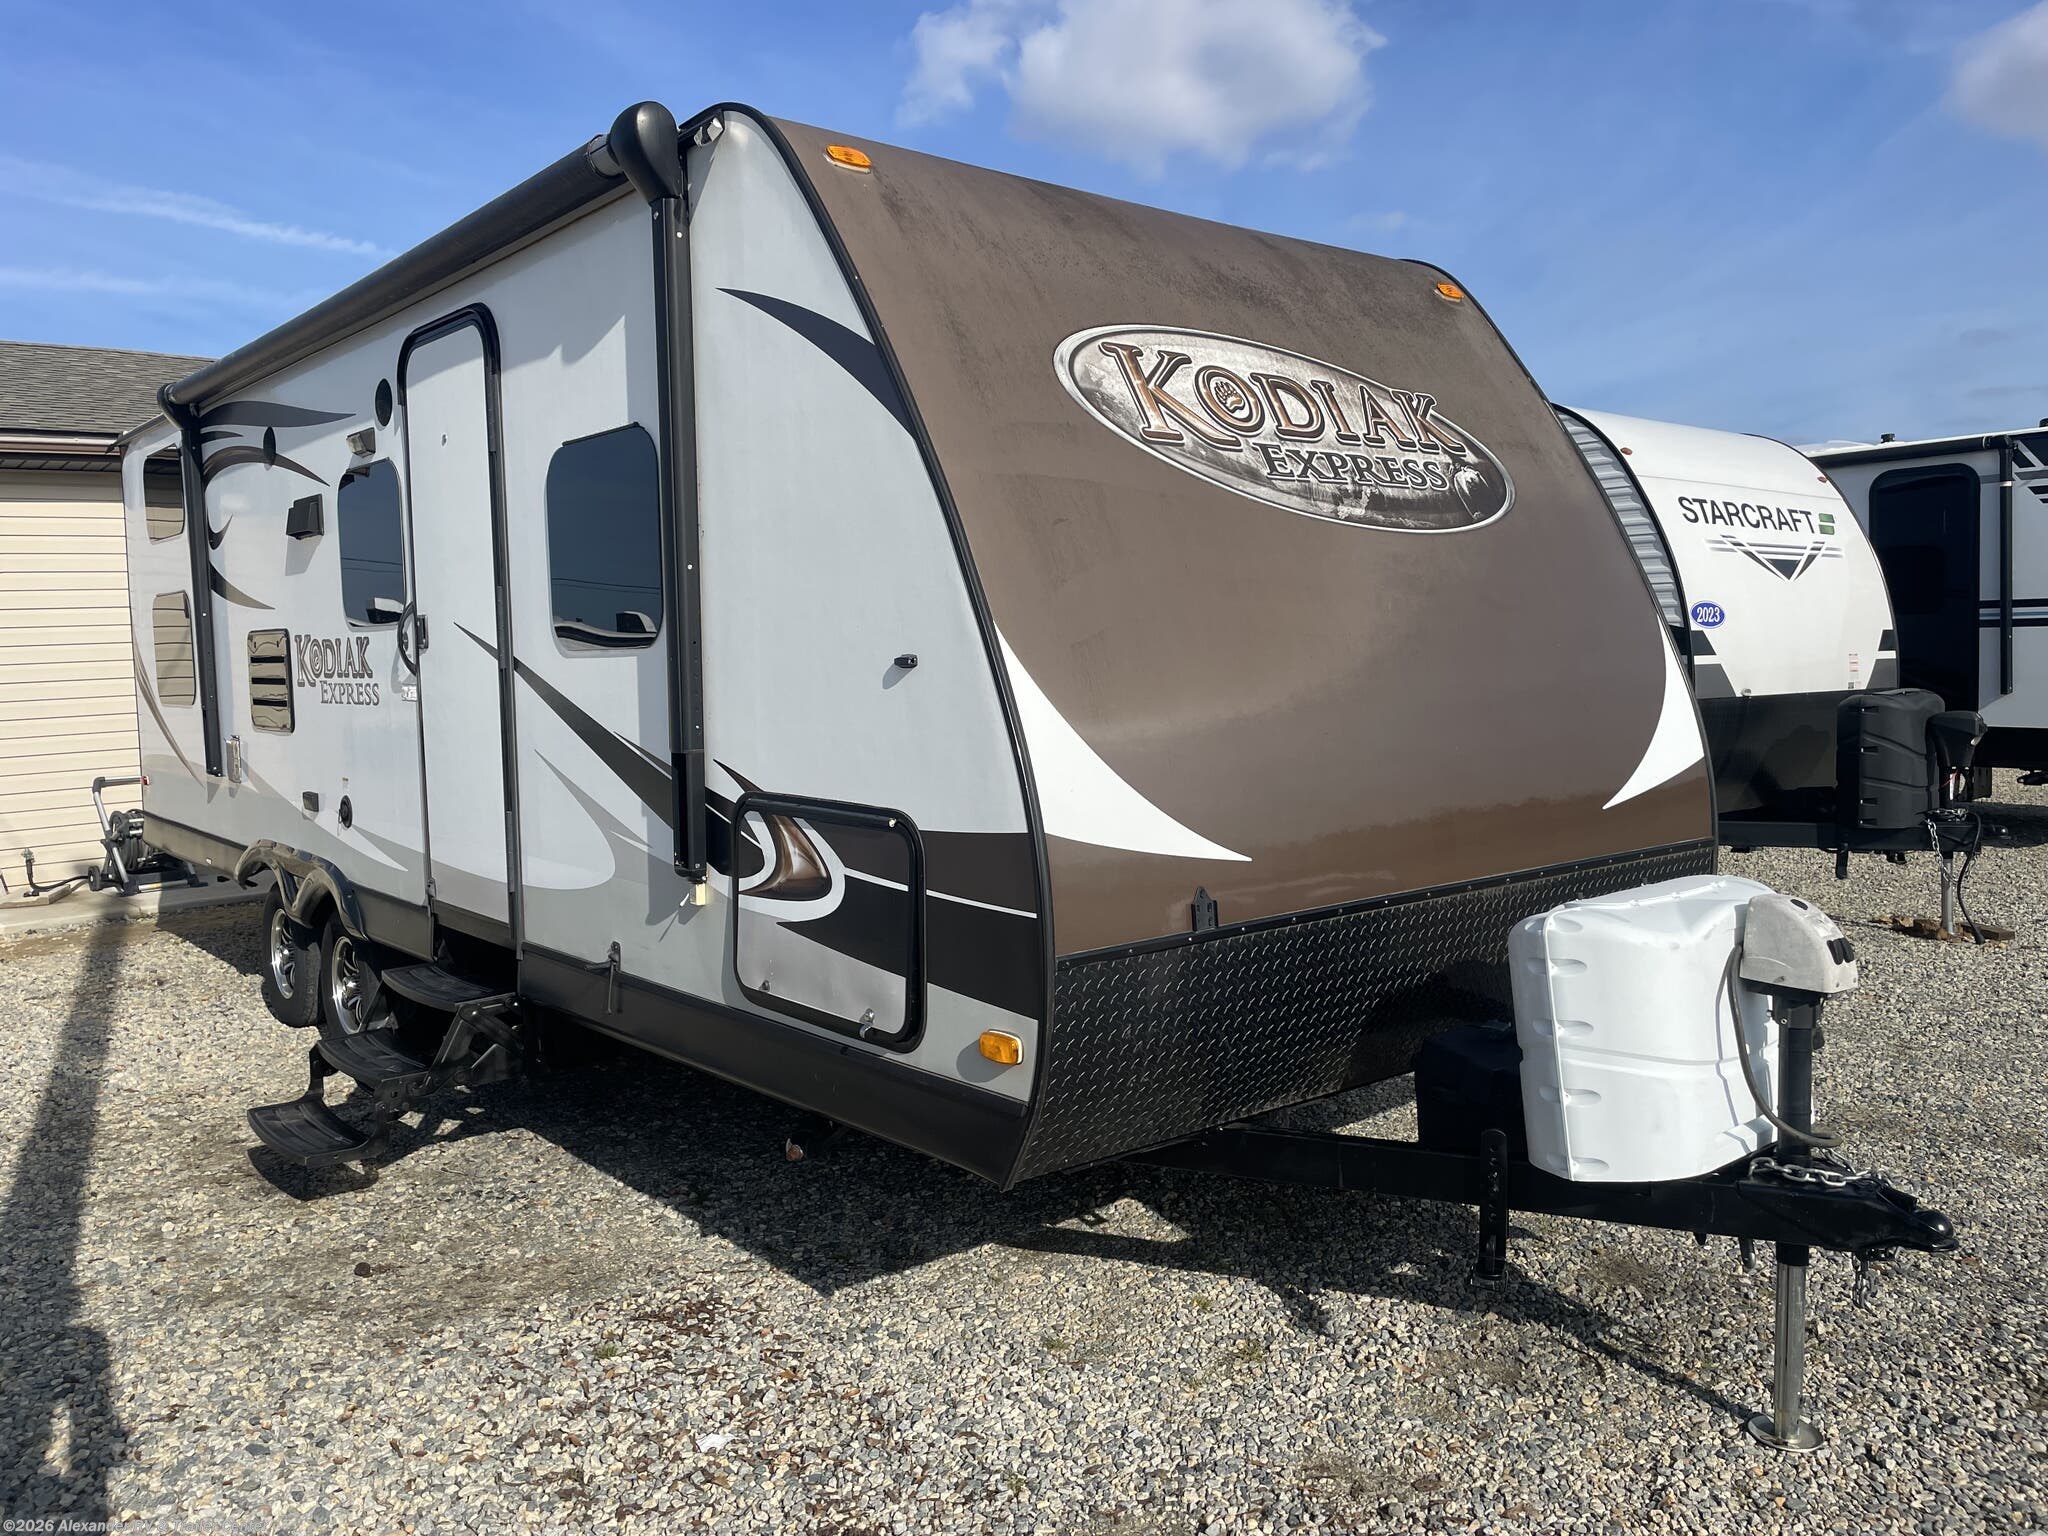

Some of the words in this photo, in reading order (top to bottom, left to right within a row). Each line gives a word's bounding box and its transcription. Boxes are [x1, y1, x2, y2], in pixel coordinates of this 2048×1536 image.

[1099, 341, 1466, 455] KODIAK
[1252, 440, 1450, 490] EXPRESS
[1678, 496, 1815, 534] STARCRAFT
[1696, 606, 1721, 623] 2023
[295, 634, 373, 687] KODIAK
[319, 680, 380, 706] EXPRESS
